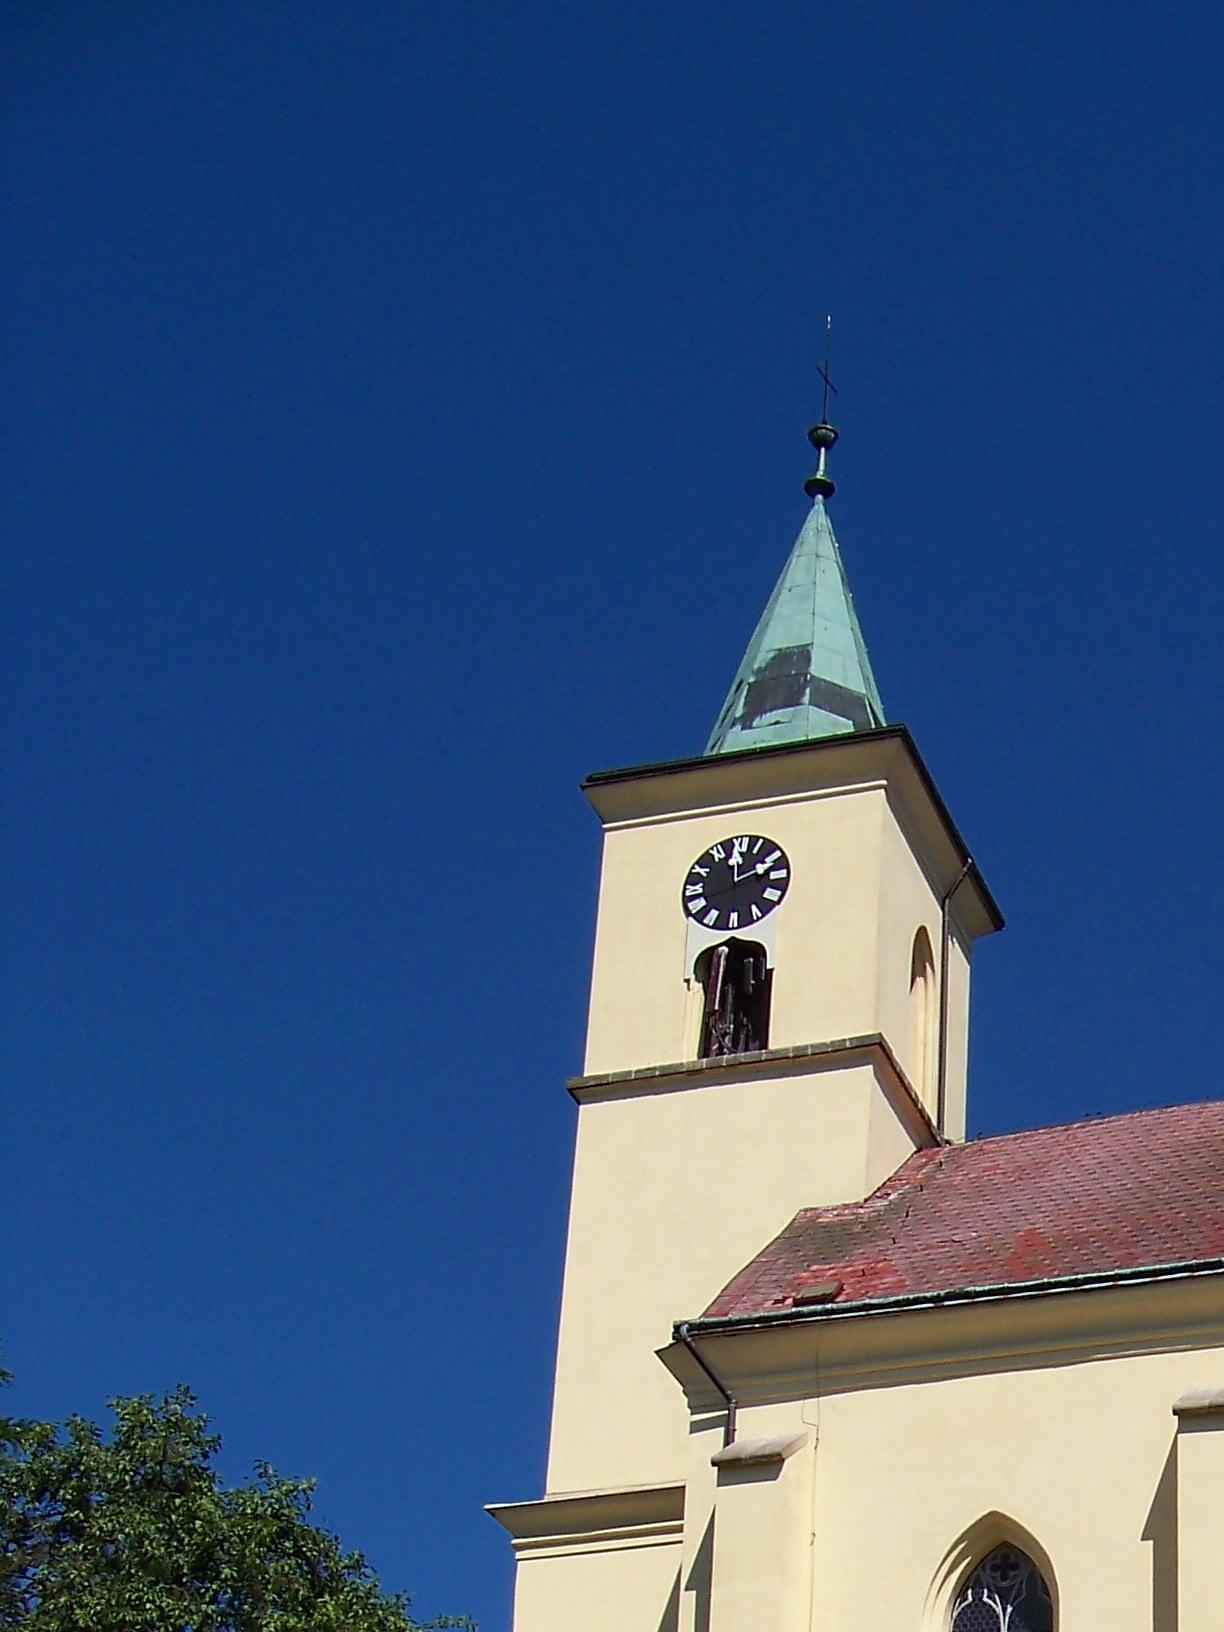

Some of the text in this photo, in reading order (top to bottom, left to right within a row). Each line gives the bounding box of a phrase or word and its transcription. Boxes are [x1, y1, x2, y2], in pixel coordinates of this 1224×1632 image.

[709, 845, 726, 862] XI
[753, 839, 764, 853] I
[692, 865, 710, 876] X
[686, 883, 703, 896] IX
[751, 904, 761, 920] V
[729, 912, 738, 928] VI
